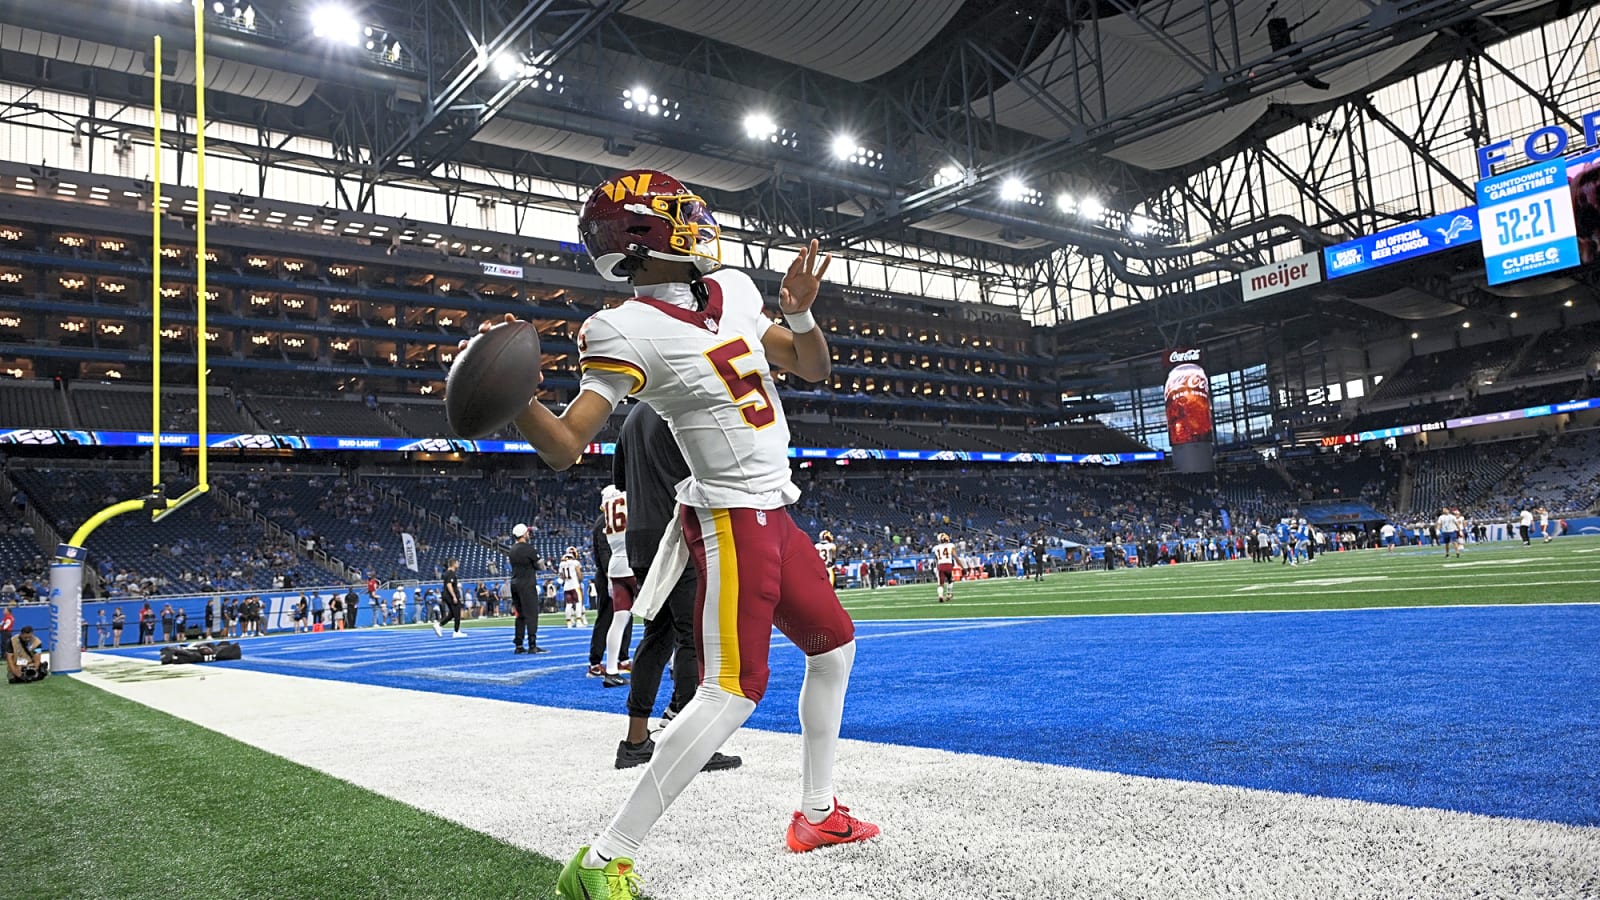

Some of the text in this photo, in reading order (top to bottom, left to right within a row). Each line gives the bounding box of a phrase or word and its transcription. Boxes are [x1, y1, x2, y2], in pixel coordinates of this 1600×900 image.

[1483, 166, 1557, 194] COUNTDOWN TO
[1489, 175, 1554, 201] GAMETIME
[1495, 198, 1556, 246] 52:21
[1371, 237, 1429, 260] BEER SPONSOR
[1375, 229, 1422, 249] AN OFFICIAL
[1333, 249, 1362, 269] BUD LIGHT
[1502, 251, 1545, 270] CURE
[1251, 262, 1309, 292] meijer
[703, 336, 776, 431] 5
[604, 497, 627, 535] 16
[935, 547, 950, 559] 14
